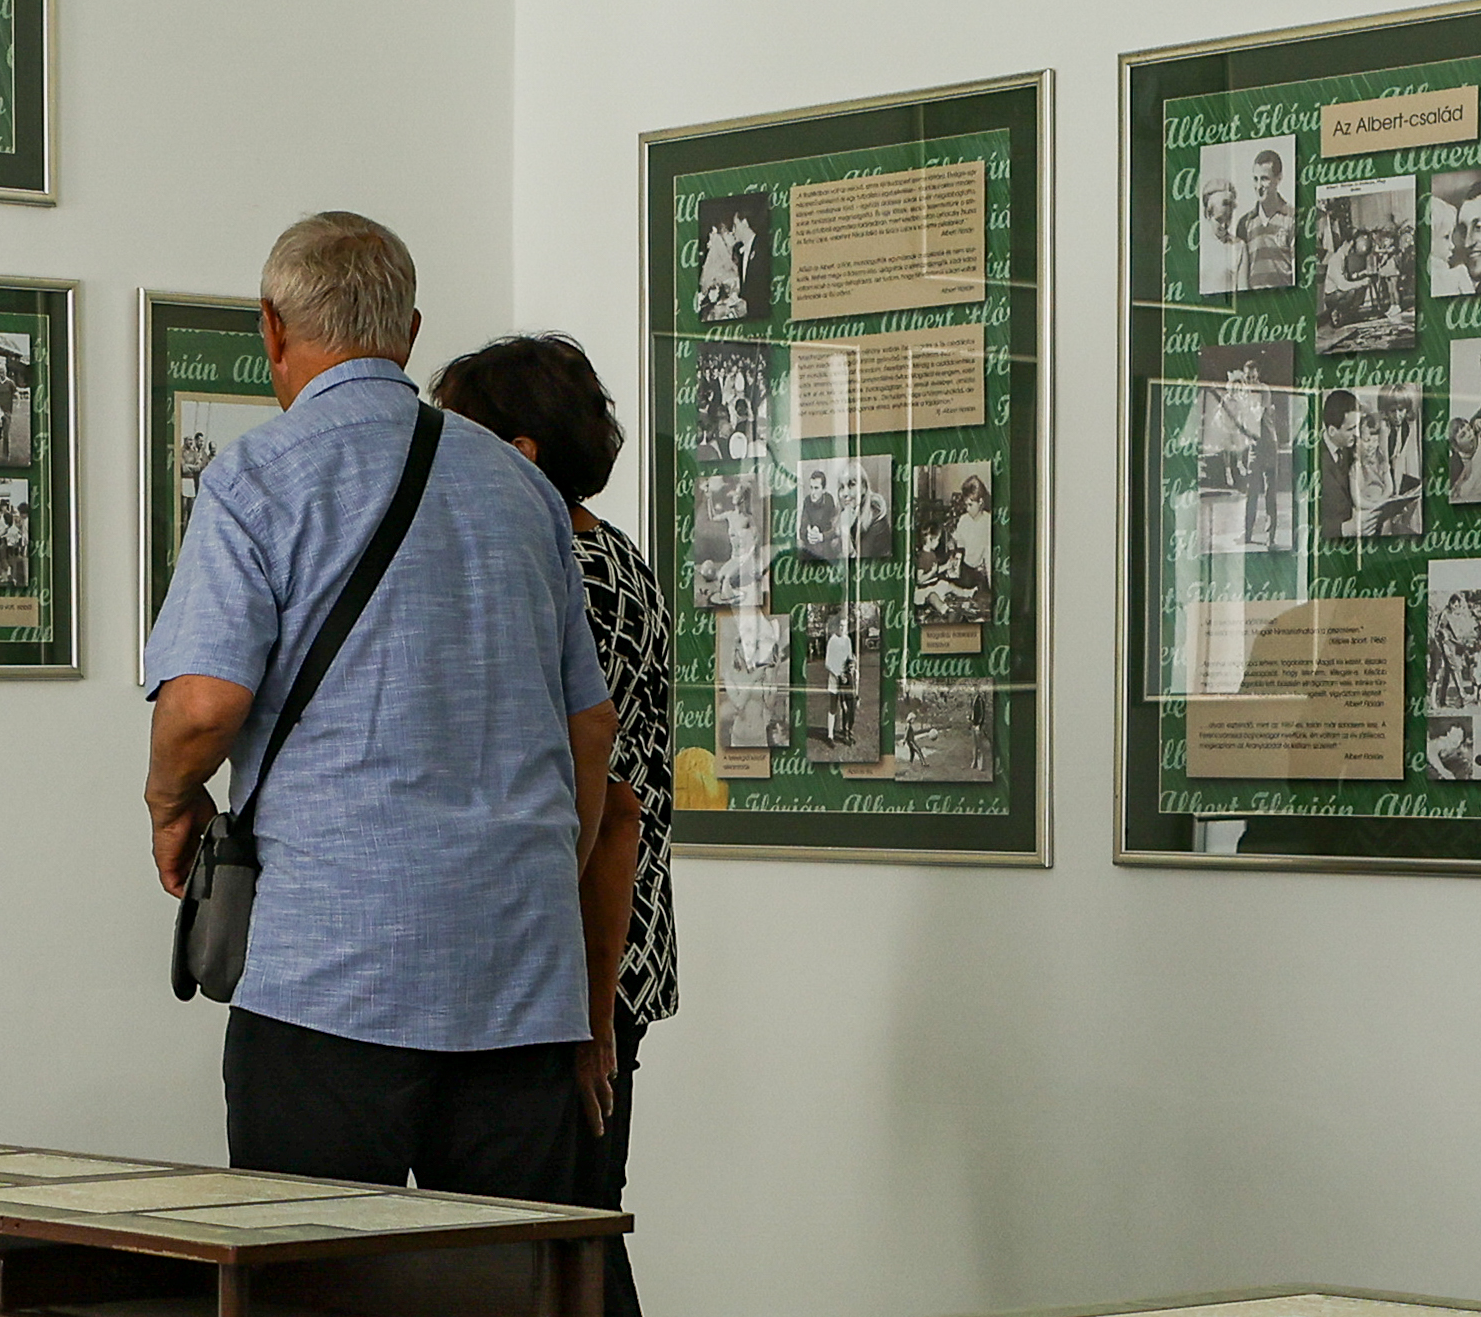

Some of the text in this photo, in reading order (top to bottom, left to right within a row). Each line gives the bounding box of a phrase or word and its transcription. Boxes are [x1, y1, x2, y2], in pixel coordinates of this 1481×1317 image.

[1165, 108, 1242, 151] Albert
[1332, 104, 1464, 137] Az Albert-család
